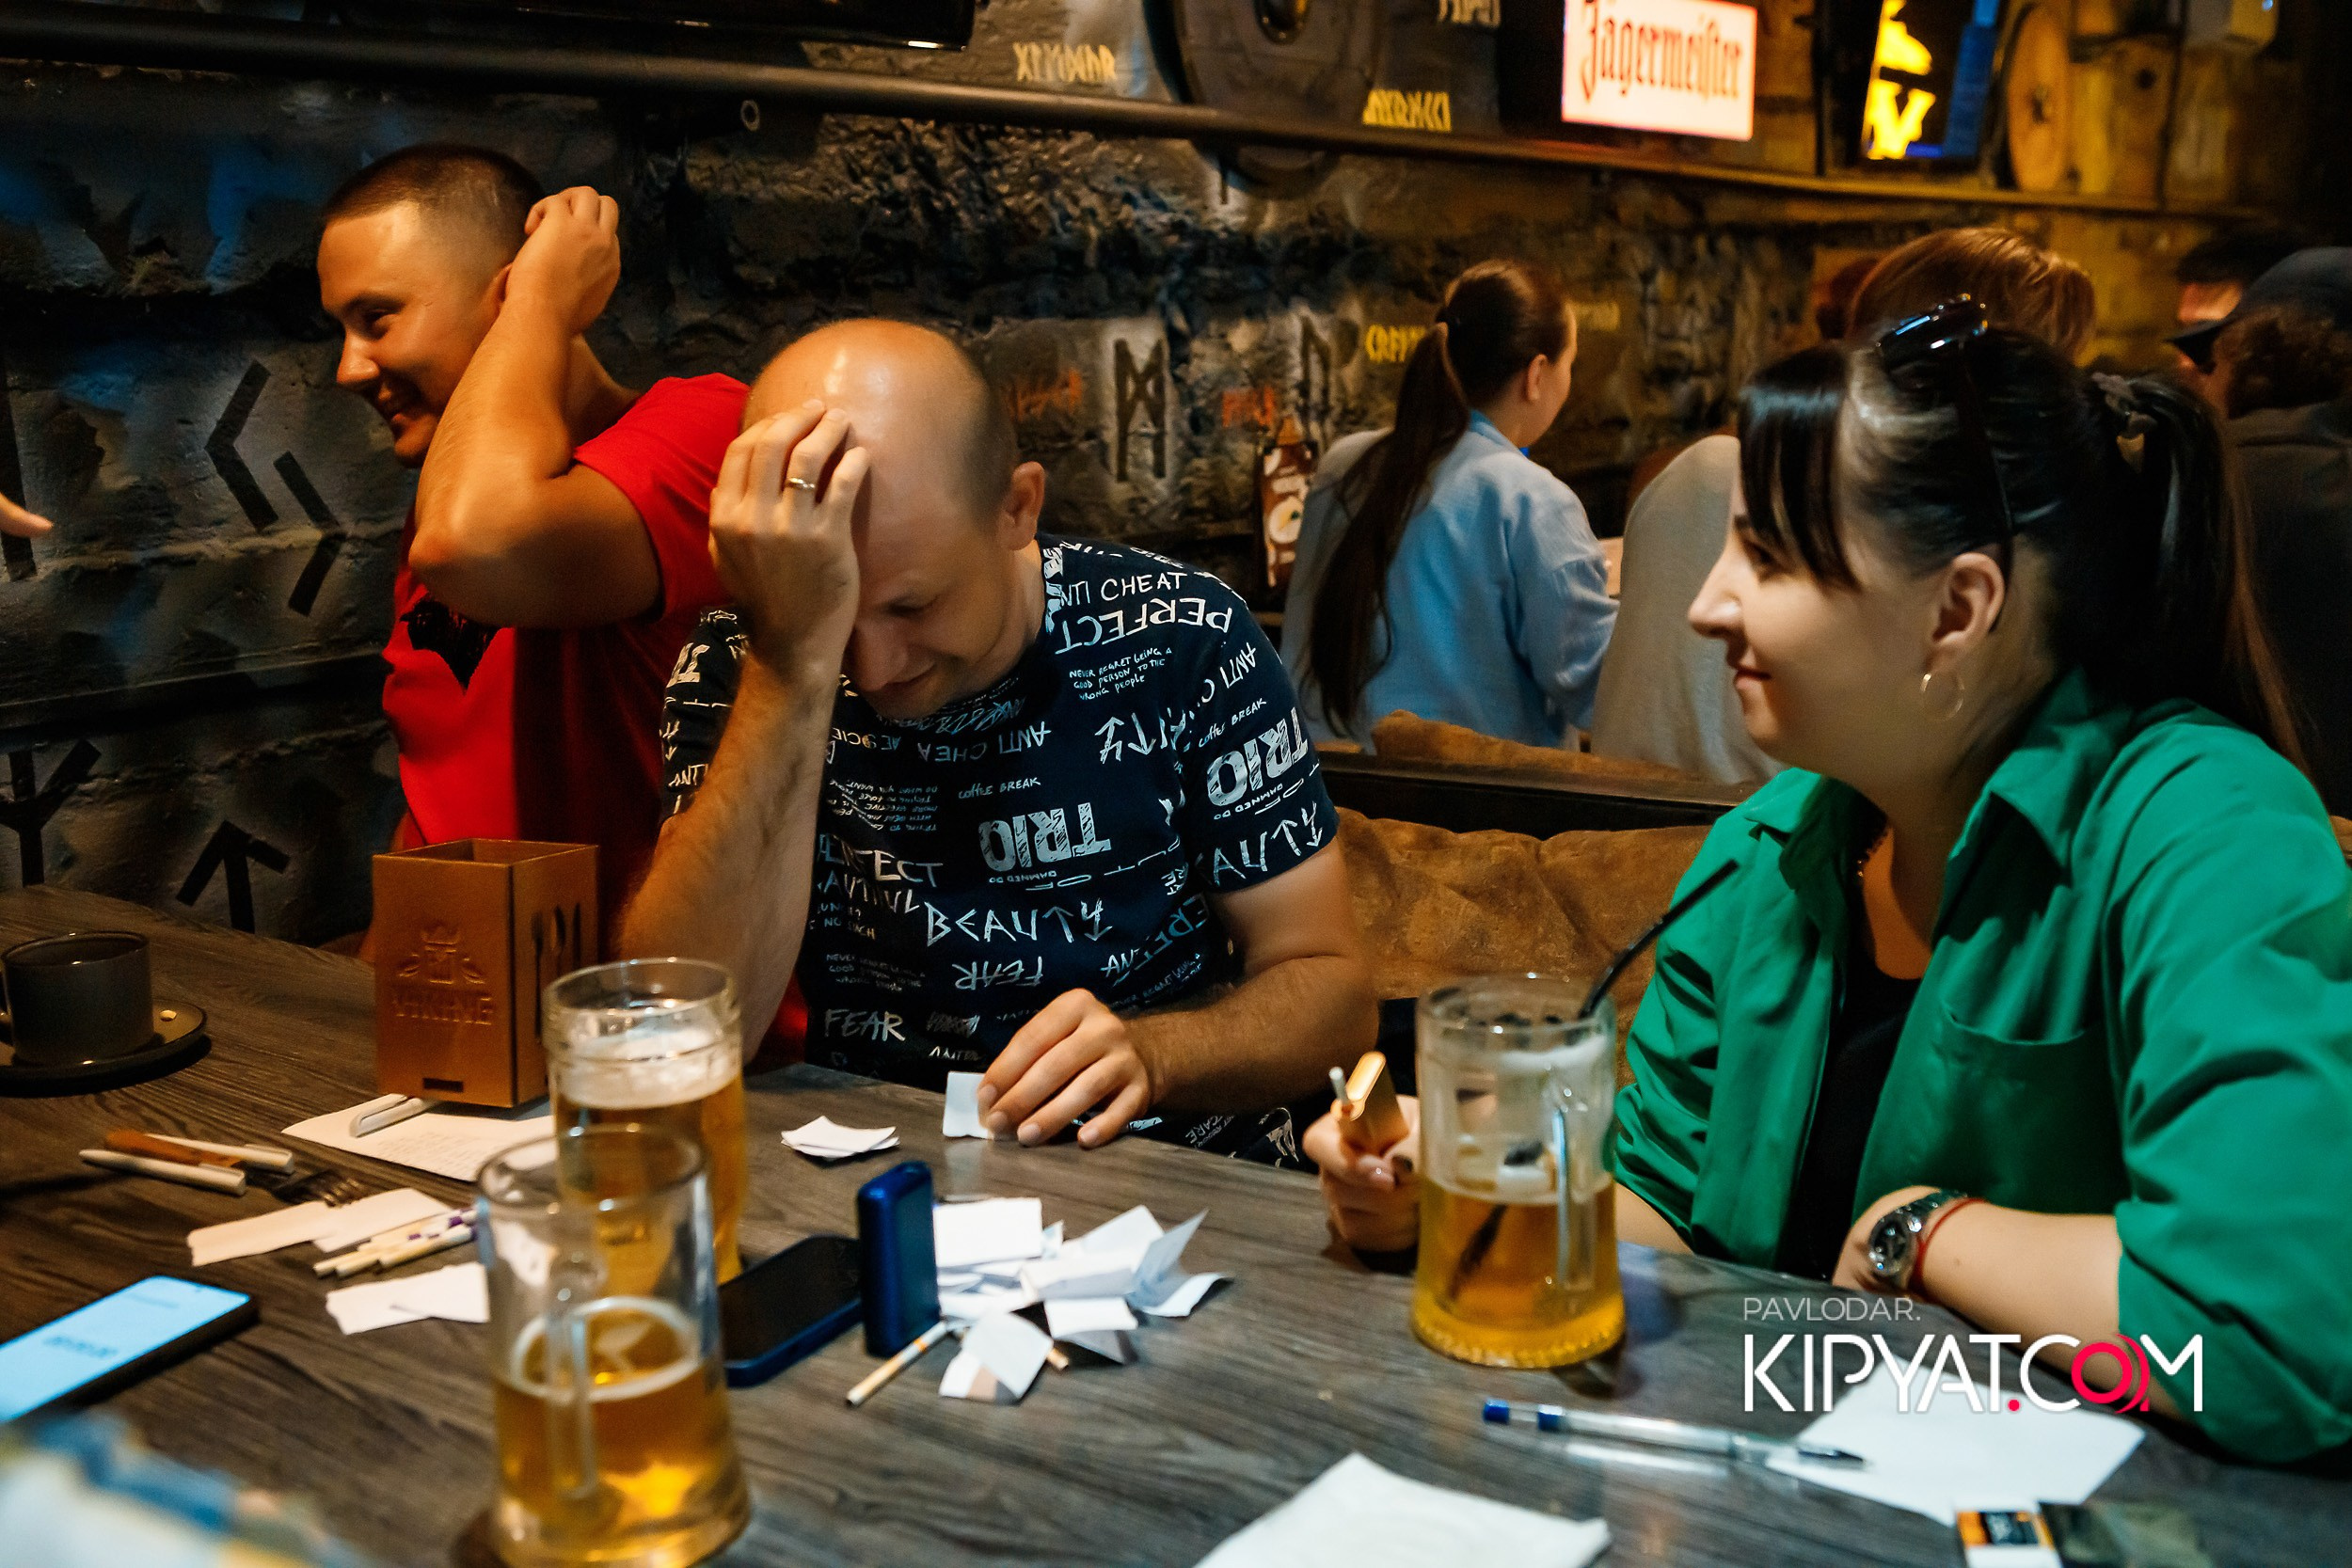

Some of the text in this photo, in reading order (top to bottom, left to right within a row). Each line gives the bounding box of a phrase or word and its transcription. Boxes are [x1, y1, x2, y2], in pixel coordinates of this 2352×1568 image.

[1060, 571, 1187, 606] NTI CHEAT
[1055, 596, 1232, 655] PERFECT
[1219, 641, 1257, 689] ANTI
[1231, 697, 1267, 726] BREAK
[916, 742, 988, 763] CHEA
[998, 720, 1053, 754] ANTI
[1206, 706, 1309, 807] TRIO
[999, 778, 1041, 797] BREAK
[977, 801, 1112, 872] TRIO
[1214, 800, 1324, 888] AUTY
[924, 897, 1113, 947] BEAUTY
[951, 956, 1043, 990] FEAR
[824, 1008, 906, 1041] FEAR
